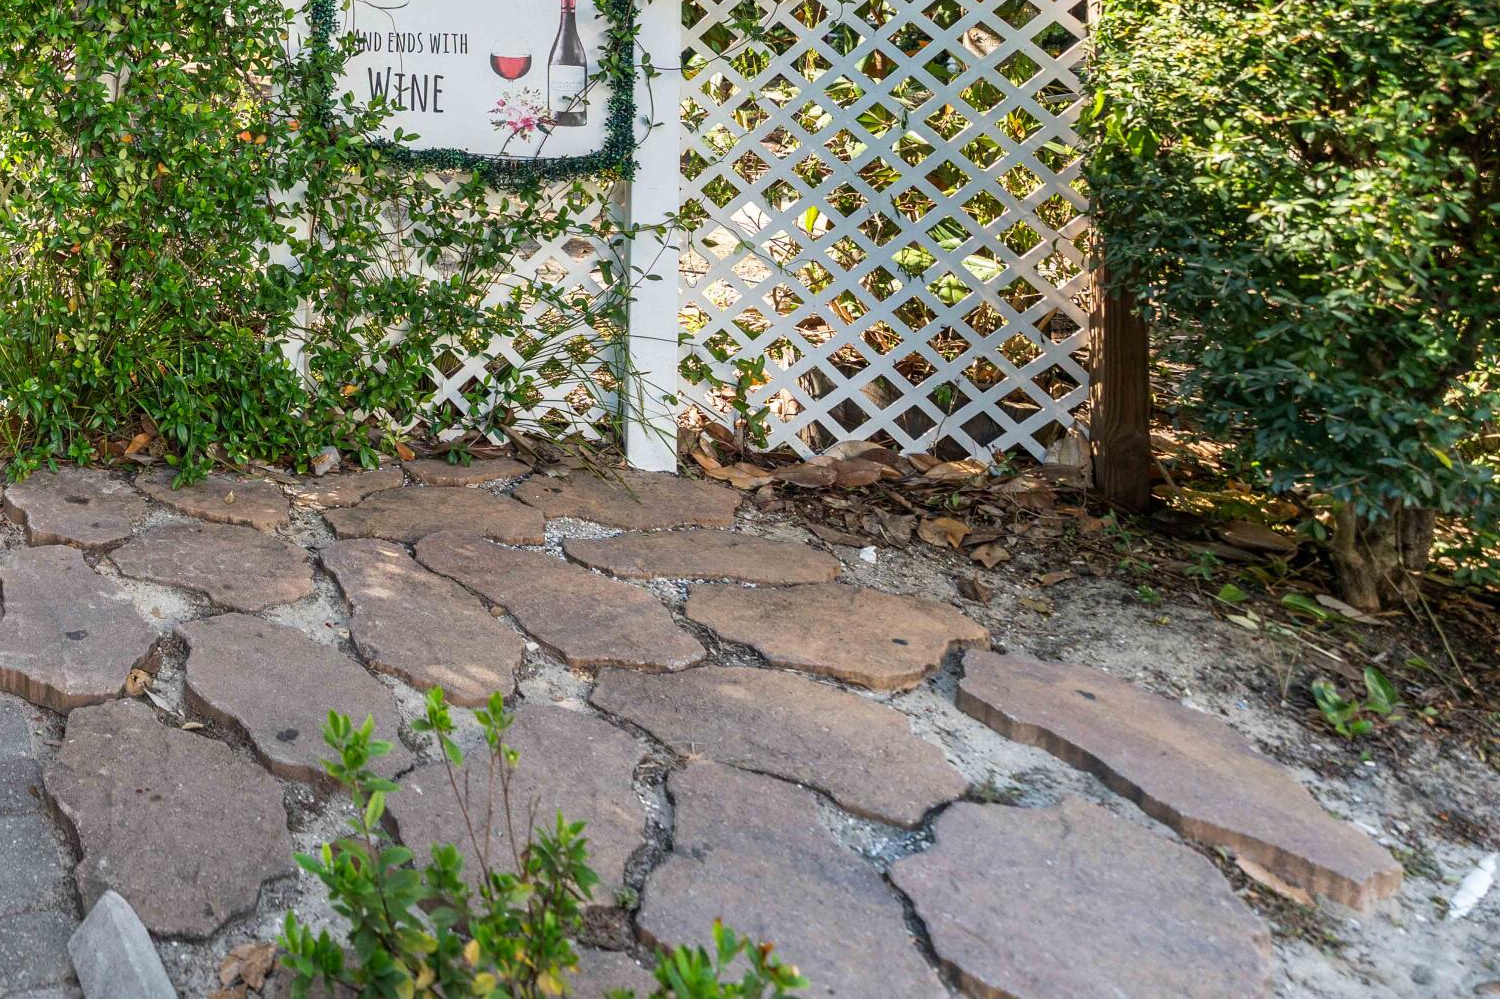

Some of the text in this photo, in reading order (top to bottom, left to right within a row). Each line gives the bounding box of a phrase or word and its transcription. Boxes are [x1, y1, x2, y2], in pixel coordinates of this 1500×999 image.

[387, 32, 424, 54] ENDS
[429, 32, 468, 54] WITH
[367, 66, 444, 113] WINE
